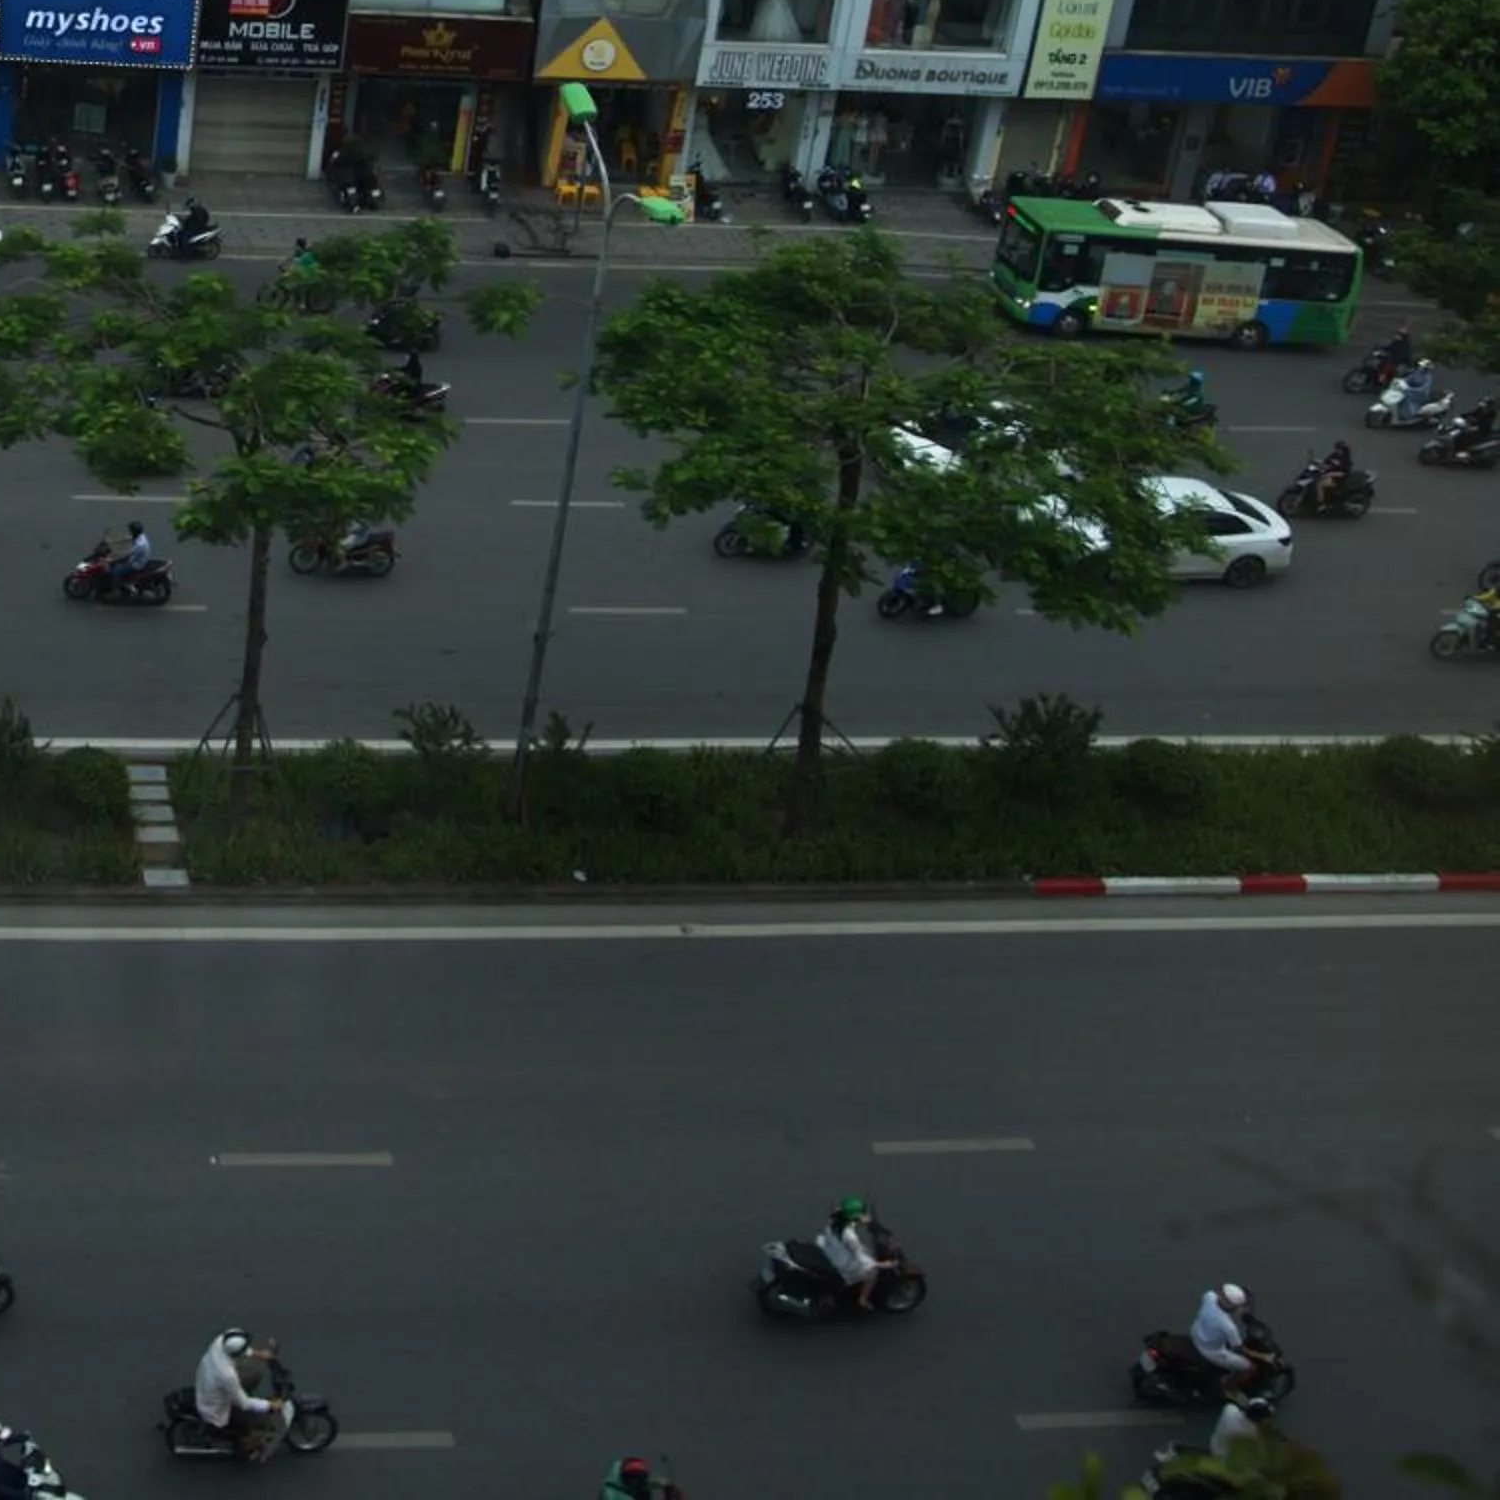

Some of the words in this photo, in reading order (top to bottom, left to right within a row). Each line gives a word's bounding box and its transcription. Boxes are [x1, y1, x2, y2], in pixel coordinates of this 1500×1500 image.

[24, 7, 165, 38] myshoes
[228, 21, 317, 40] MOBILE
[924, 66, 1009, 86] BOUTIQUE
[1228, 76, 1273, 99] VIB
[745, 91, 785, 110] 253
